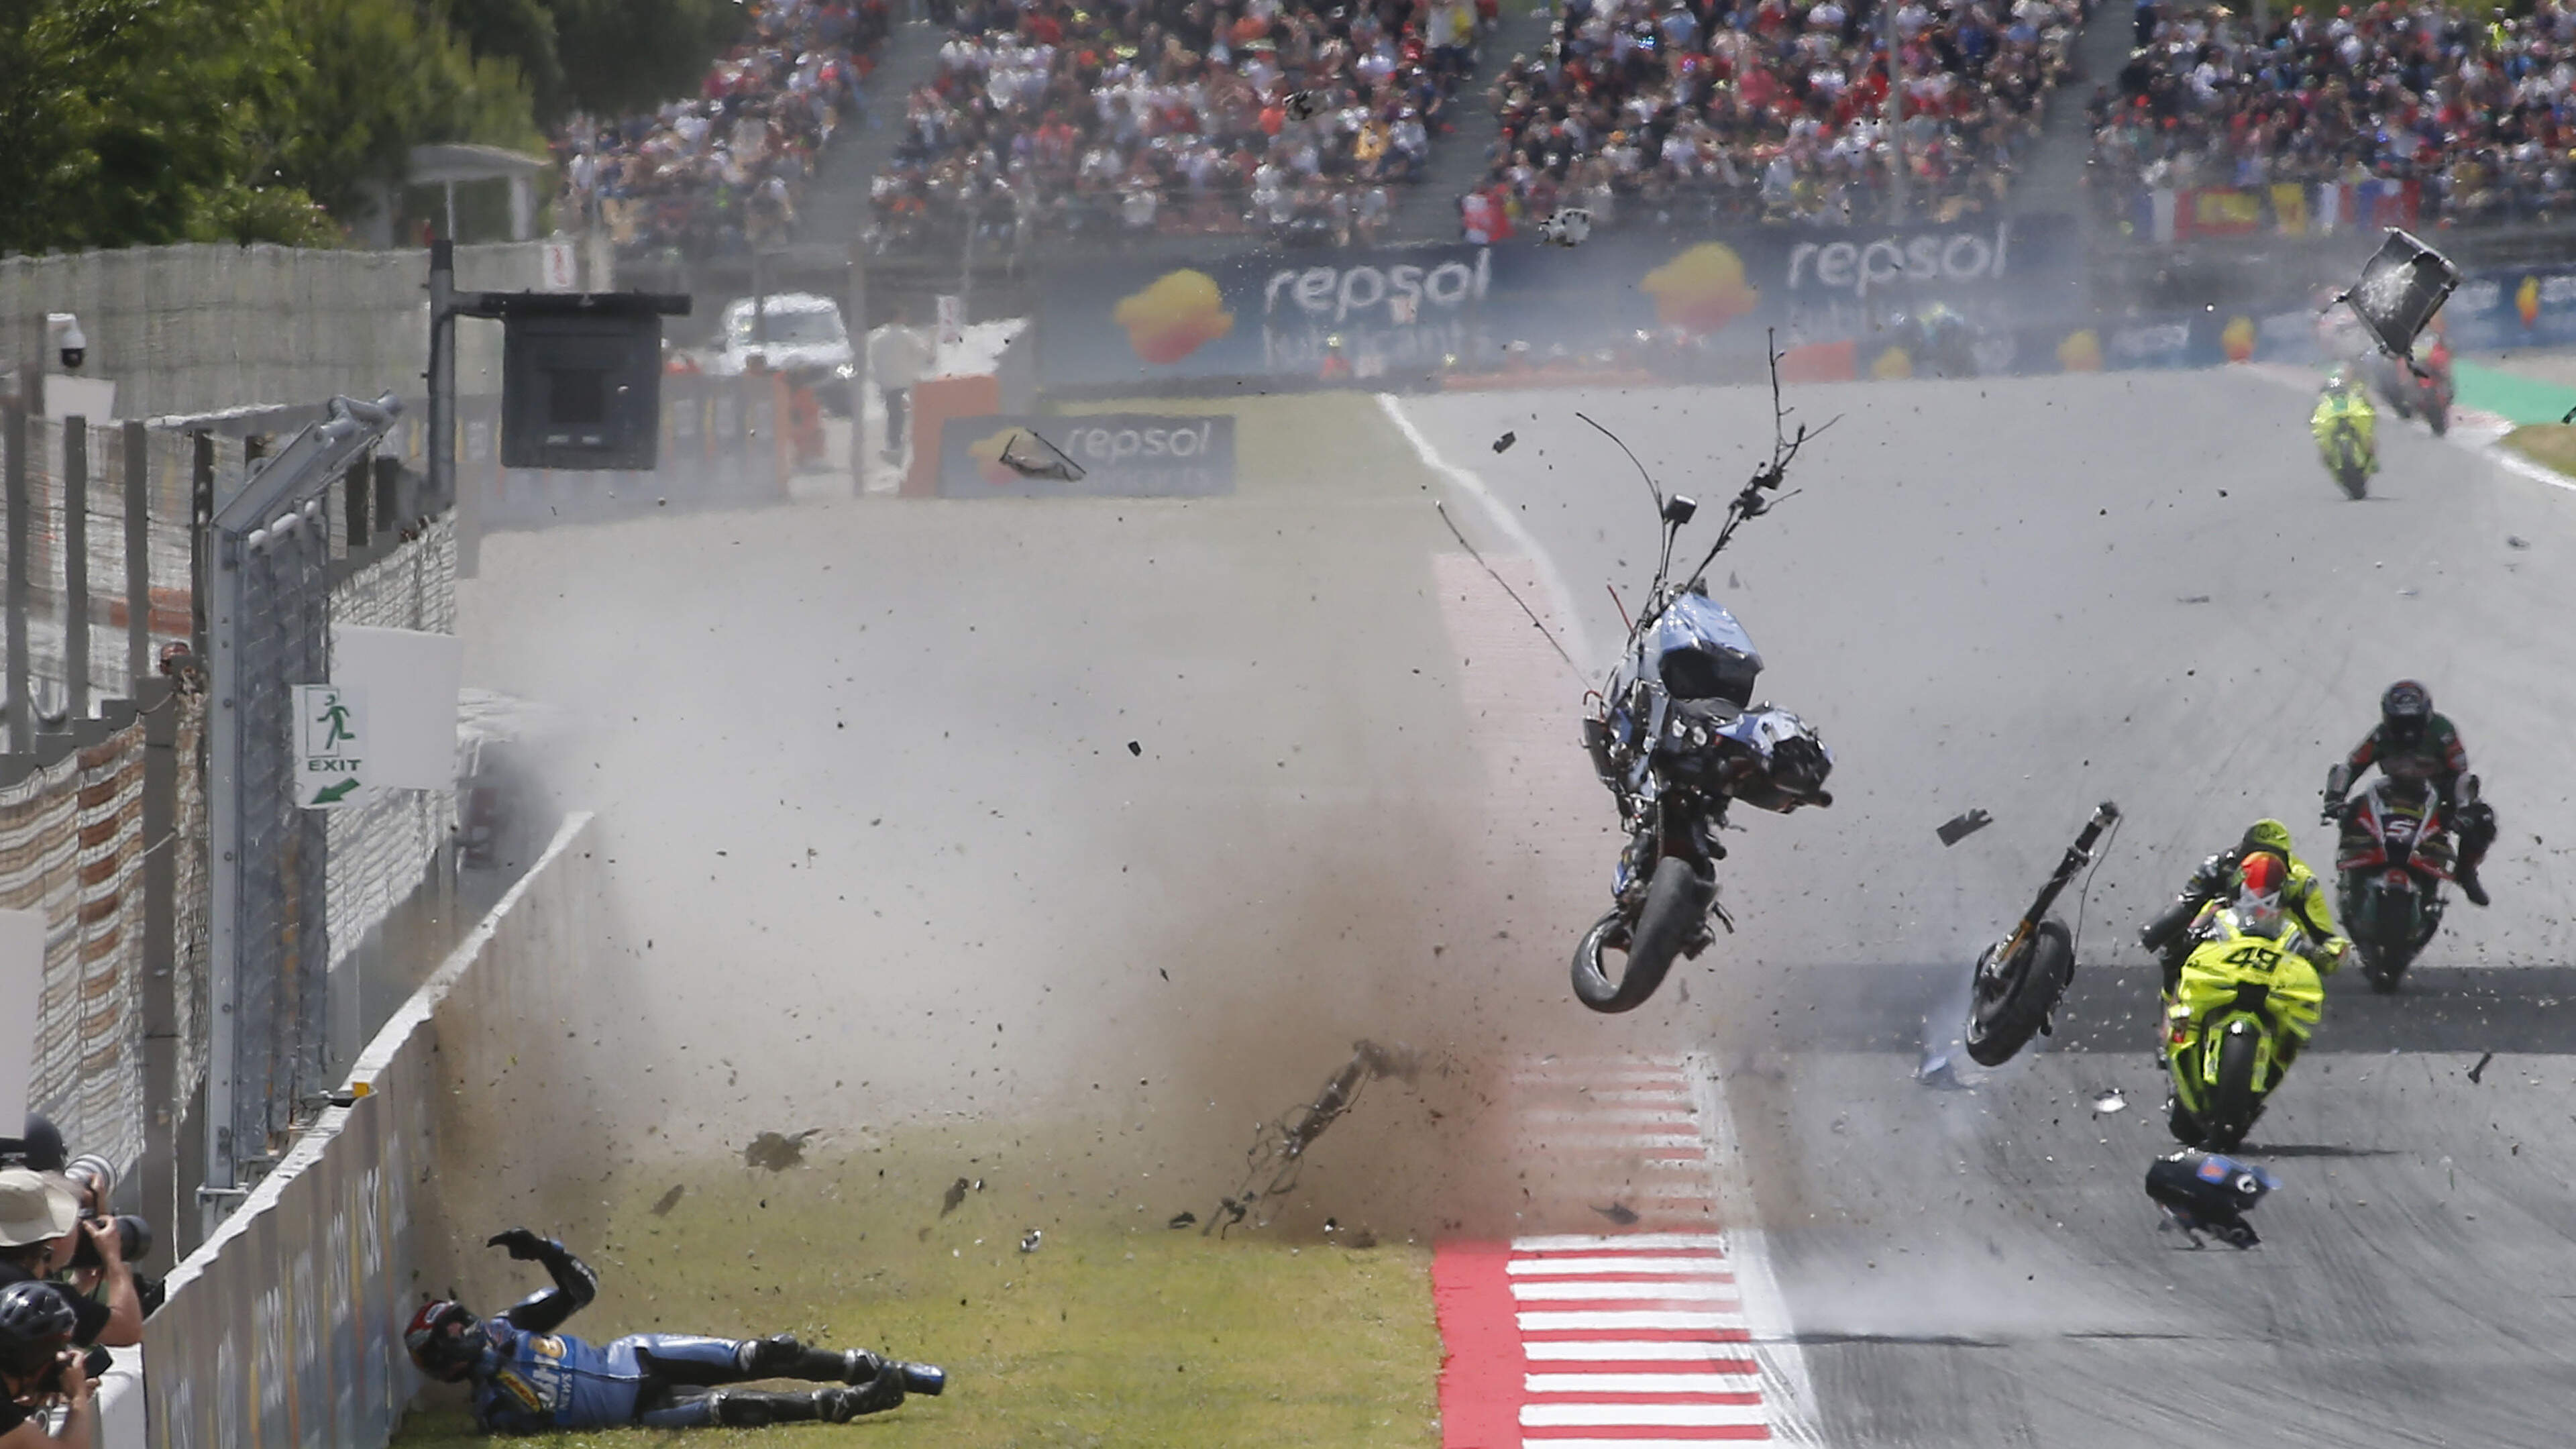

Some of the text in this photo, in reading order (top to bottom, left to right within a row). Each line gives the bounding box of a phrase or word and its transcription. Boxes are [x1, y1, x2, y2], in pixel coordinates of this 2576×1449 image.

[1788, 221, 2008, 297] repsol
[1264, 247, 1491, 321] repsol
[1064, 421, 1212, 464] repsol
[308, 759, 362, 772] EXIT
[2224, 947, 2282, 973] 49
